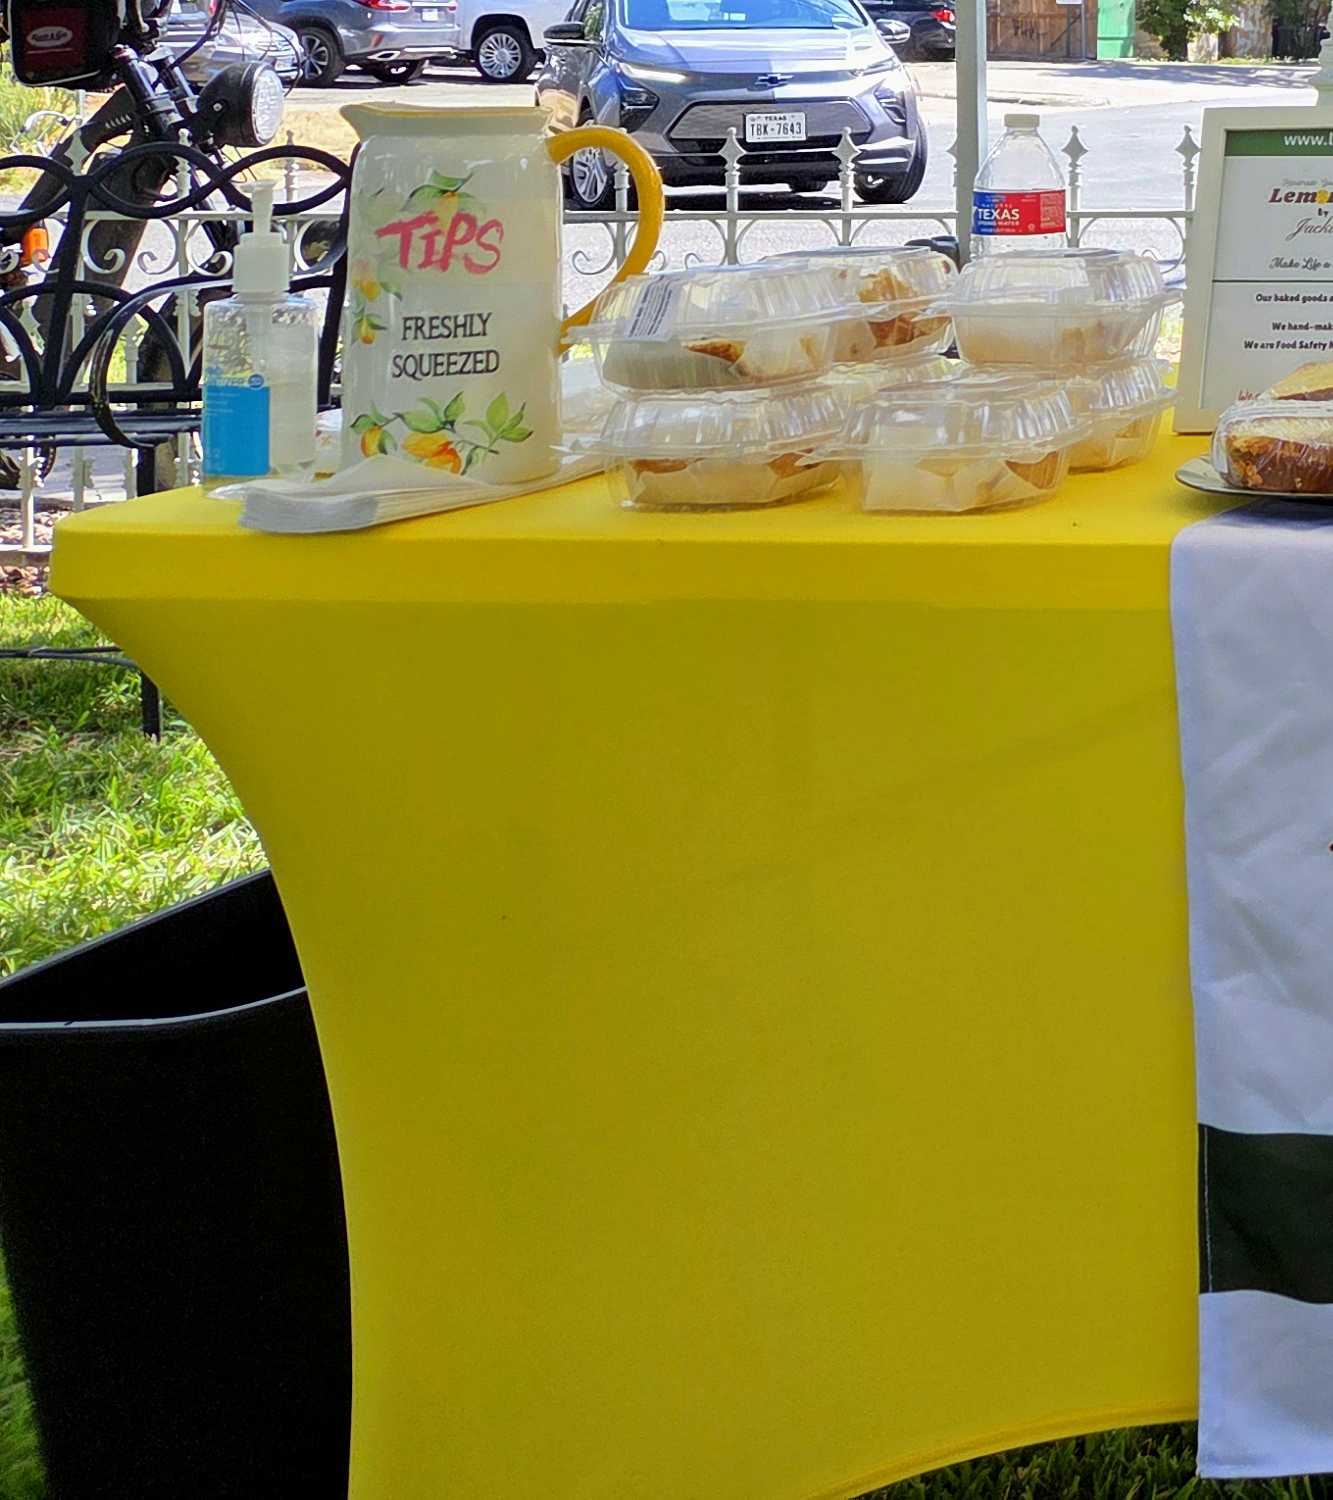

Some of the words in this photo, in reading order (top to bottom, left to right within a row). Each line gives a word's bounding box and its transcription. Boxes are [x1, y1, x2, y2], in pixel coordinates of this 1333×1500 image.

[977, 208, 1020, 220] TEXAS
[1317, 207, 1330, 218] by
[1269, 257, 1300, 269] Make
[1301, 256, 1322, 270] Life
[1255, 293, 1272, 302] Our
[1274, 293, 1300, 302] baked
[1301, 293, 1327, 304] goods
[402, 312, 493, 341] FRESHLY
[1272, 322, 1286, 331] We
[1244, 340, 1258, 349] We
[1276, 340, 1297, 349] Food
[1298, 340, 1327, 351] Safety
[392, 349, 500, 381] SQUEEZED
